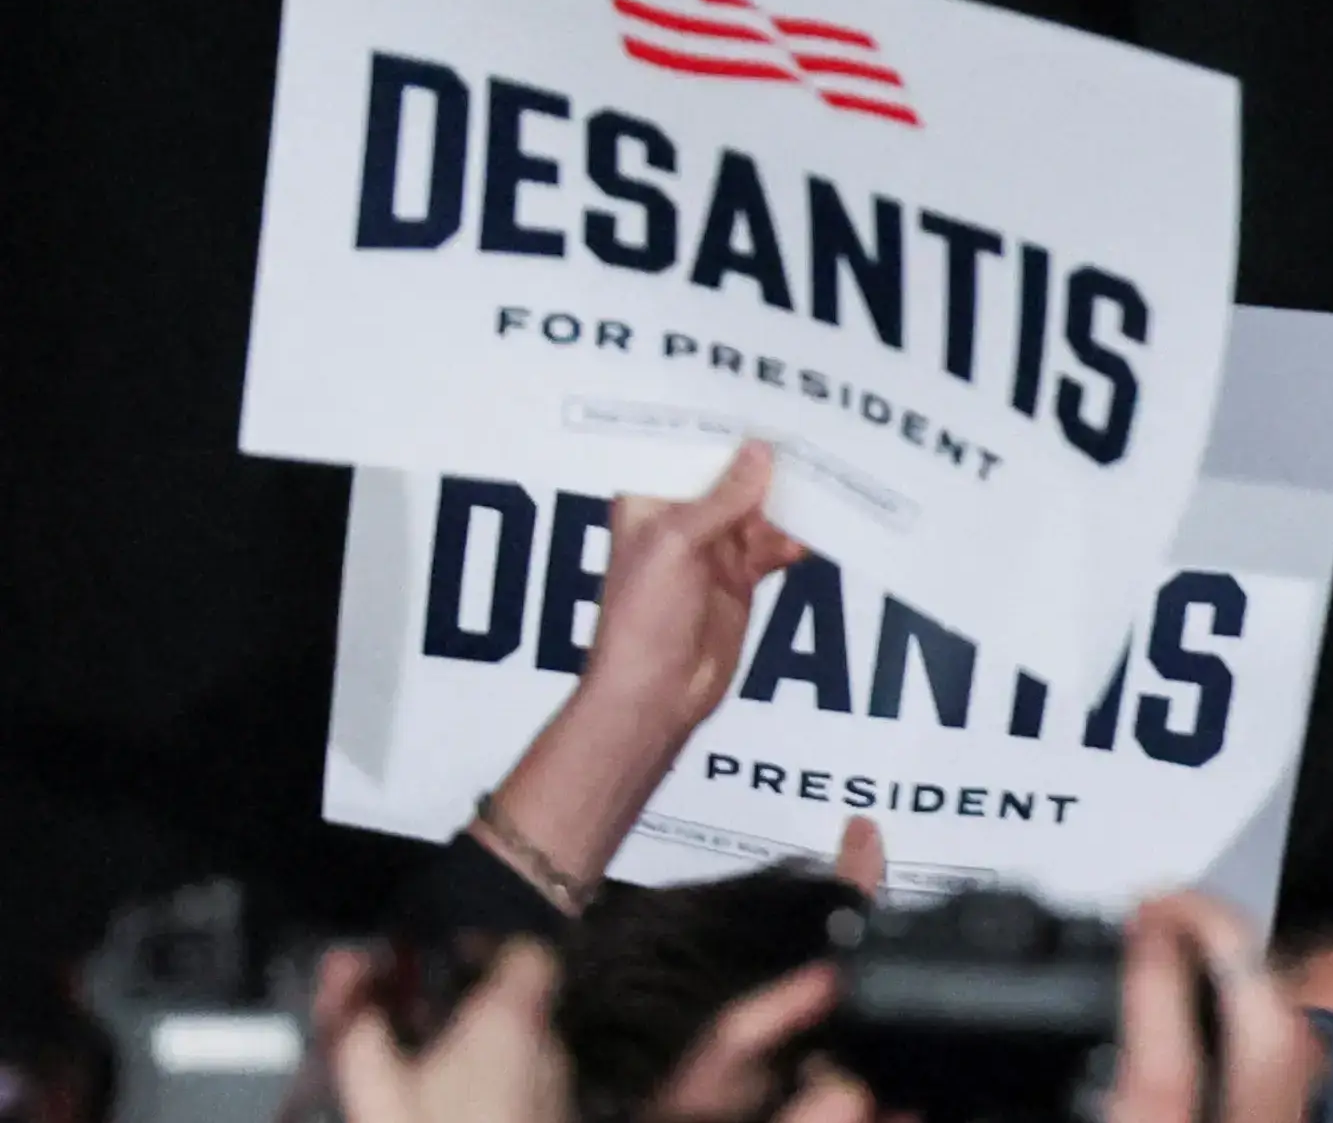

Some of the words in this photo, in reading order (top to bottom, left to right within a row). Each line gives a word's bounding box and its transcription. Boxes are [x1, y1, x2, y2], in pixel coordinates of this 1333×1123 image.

[356, 49, 1149, 466] DESANTIS
[494, 306, 633, 351] FOR
[661, 331, 1003, 482] PRESIDENT
[706, 753, 1079, 825] PRESIDENT
